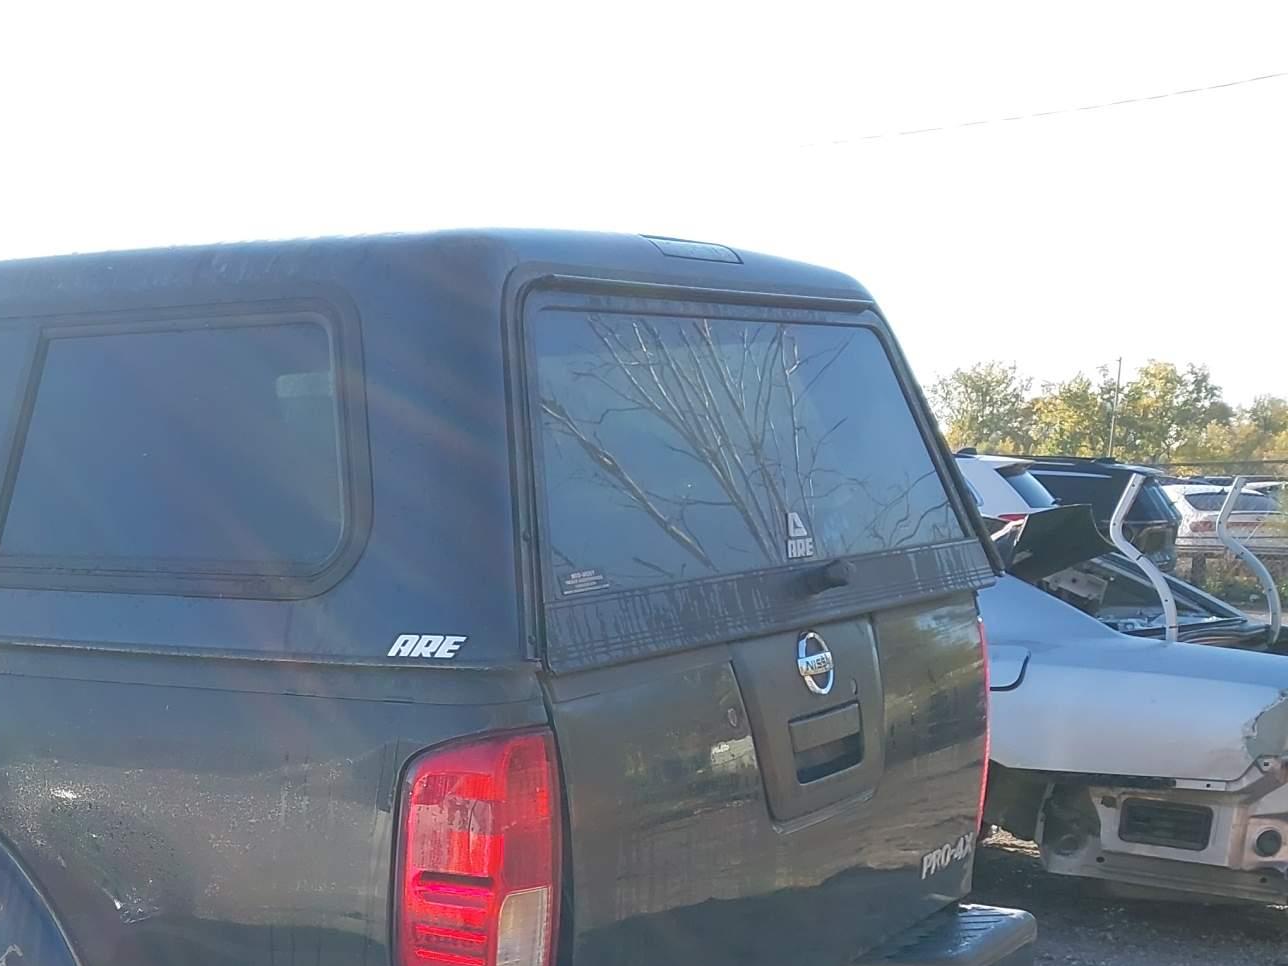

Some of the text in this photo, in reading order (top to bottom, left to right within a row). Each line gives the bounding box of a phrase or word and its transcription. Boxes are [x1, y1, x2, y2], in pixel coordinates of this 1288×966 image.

[787, 537, 814, 559] ARE
[386, 634, 468, 659] ARE
[921, 831, 974, 880] PRO-4X
